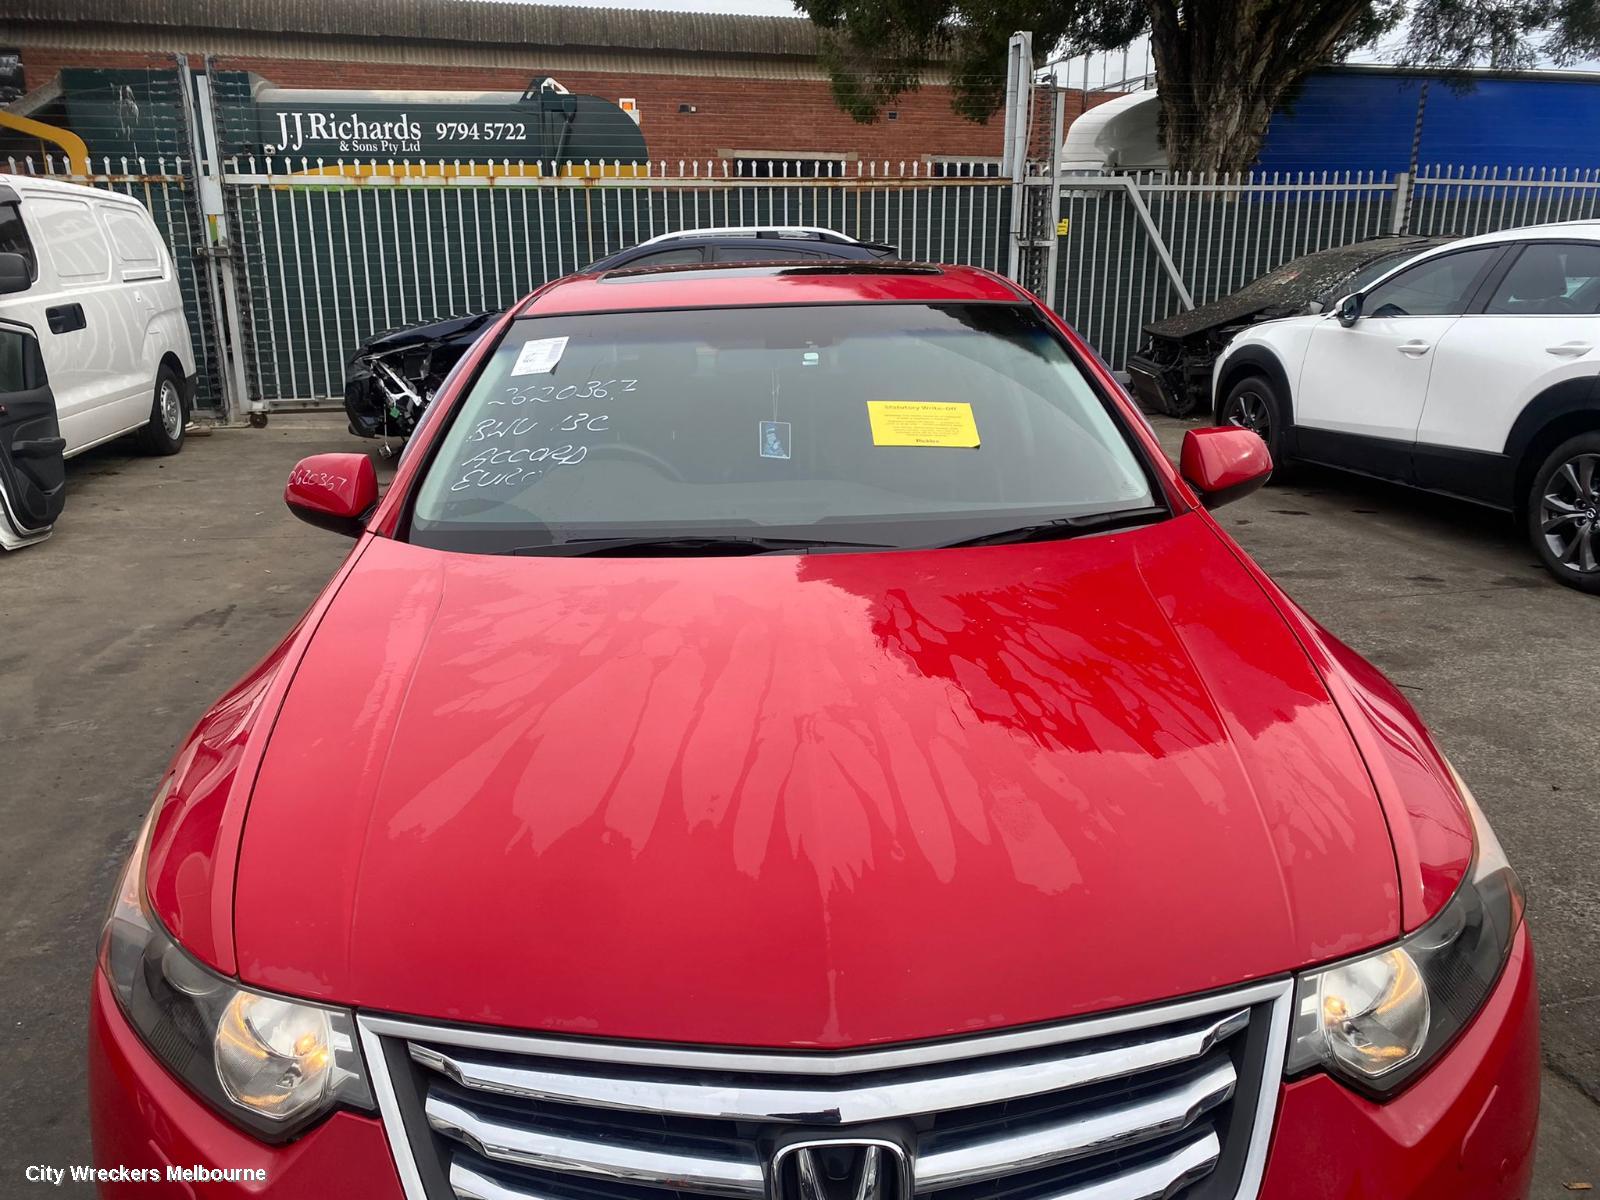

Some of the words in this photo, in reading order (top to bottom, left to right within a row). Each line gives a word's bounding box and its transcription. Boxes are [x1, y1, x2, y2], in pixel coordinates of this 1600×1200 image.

[435, 122, 480, 141] 9794
[484, 122, 527, 141] 5722
[339, 141, 350, 151] &
[352, 141, 379, 152] Sons
[381, 141, 399, 155] Pty
[402, 141, 420, 152] Ltd
